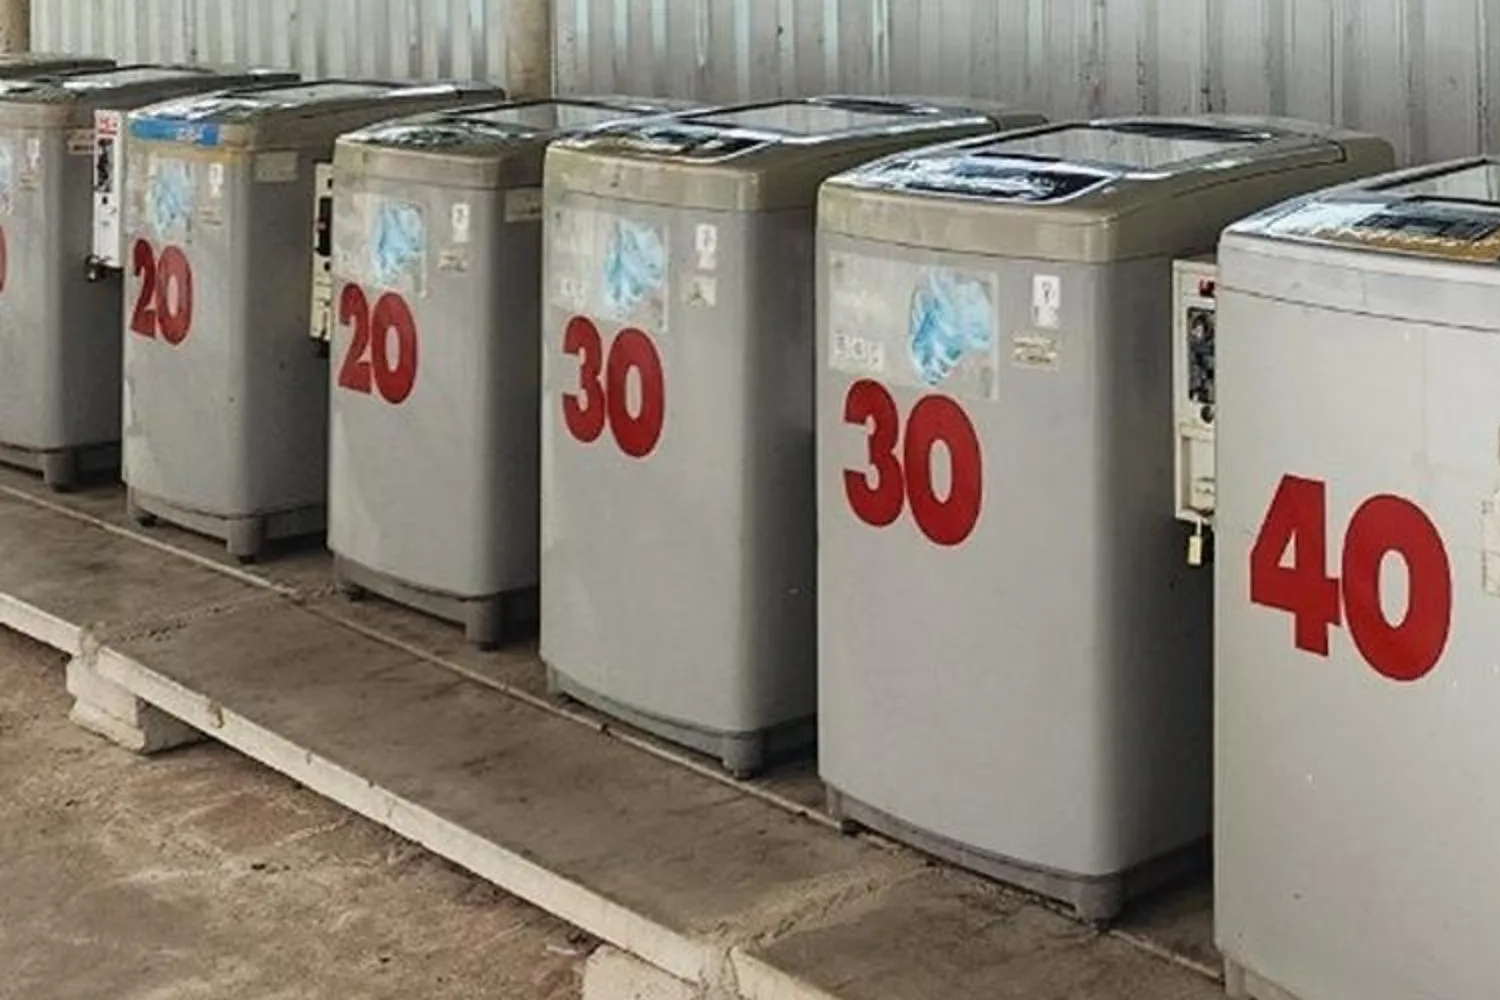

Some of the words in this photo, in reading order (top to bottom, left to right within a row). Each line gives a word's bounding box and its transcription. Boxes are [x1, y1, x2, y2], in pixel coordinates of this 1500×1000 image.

[131, 238, 194, 346] 20
[337, 282, 418, 404] 20
[562, 316, 665, 458] 30
[843, 379, 983, 547] 30
[1249, 473, 1453, 682] 40
